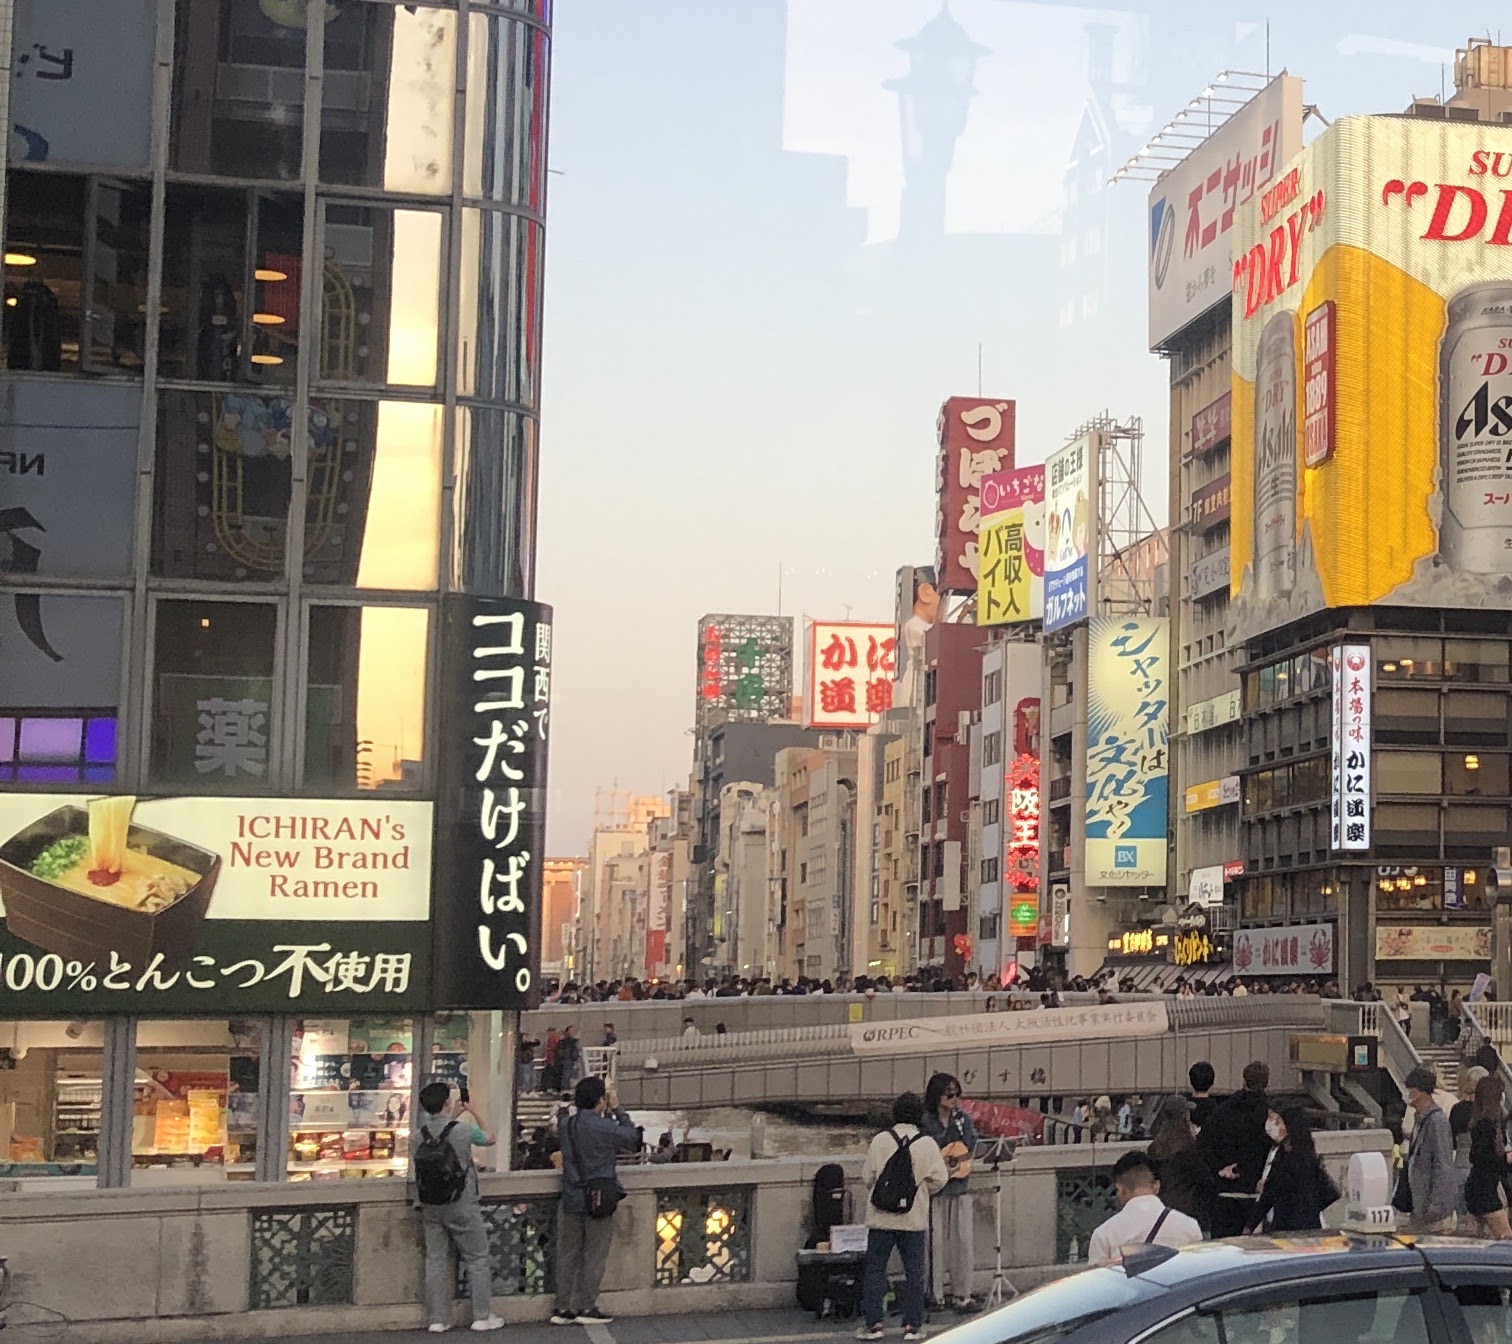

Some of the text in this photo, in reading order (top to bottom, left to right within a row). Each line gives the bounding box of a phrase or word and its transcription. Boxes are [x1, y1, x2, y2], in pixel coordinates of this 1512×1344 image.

[1183, 119, 1280, 263] 不二サッシ
[1260, 167, 1301, 227] SUPER
[1306, 369, 1328, 414] 1889
[983, 524, 1003, 621] バイト
[1003, 522, 1024, 618] 高収入
[1046, 581, 1086, 626] ガルフネット
[820, 632, 895, 672] かに
[533, 622, 551, 740] 関西で
[1110, 622, 1168, 773] シャッターは
[195, 697, 267, 777] 薬
[1348, 676, 1364, 744] 本場の味
[472, 610, 531, 993] ココだけばい。
[1346, 749, 1366, 843] かに道楽
[230, 842, 410, 870] New Brand
[238, 814, 406, 841] ICHIRAN's
[1117, 850, 1135, 863] BX
[270, 873, 379, 899] Ramen
[0, 943, 412, 998] 00%とんこつ不使用
[933, 1067, 1047, 1085] びす橋
[1371, 1209, 1391, 1223] 117
